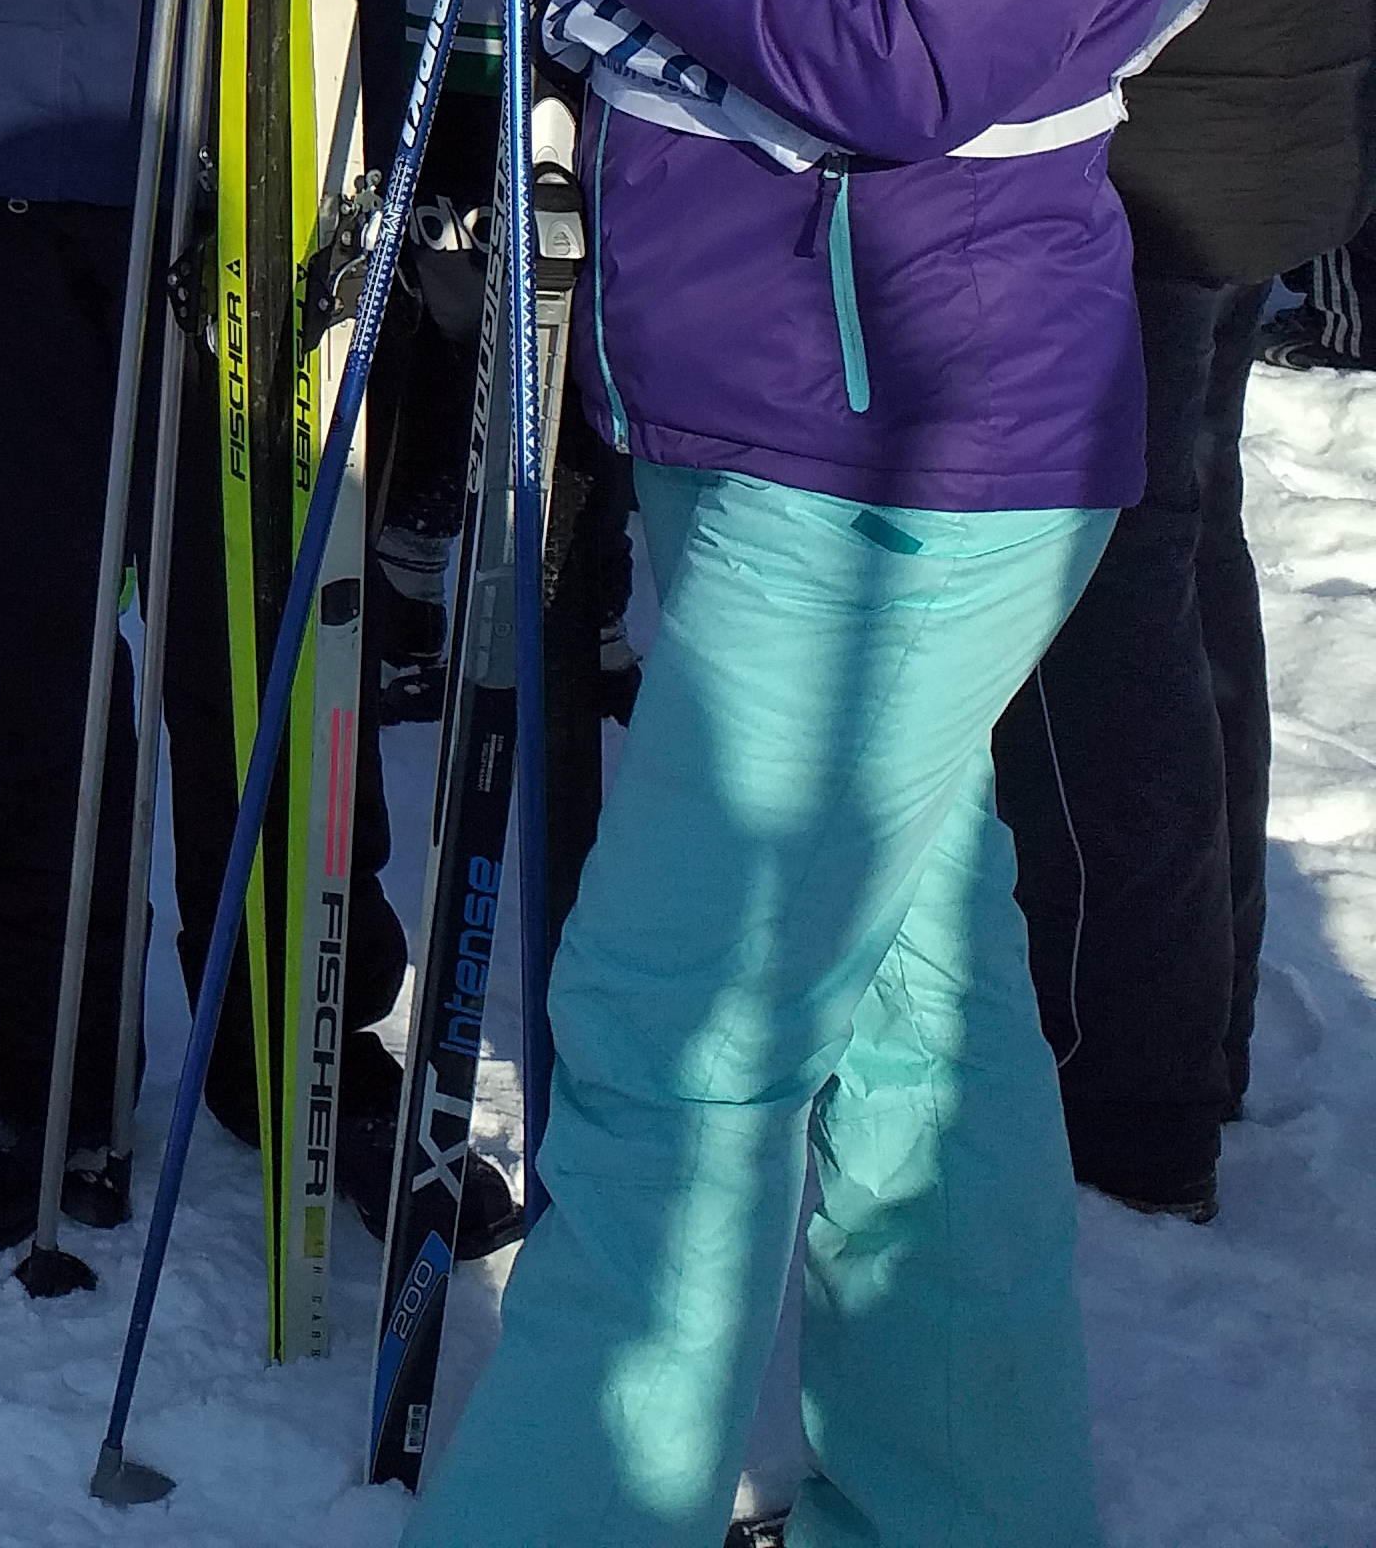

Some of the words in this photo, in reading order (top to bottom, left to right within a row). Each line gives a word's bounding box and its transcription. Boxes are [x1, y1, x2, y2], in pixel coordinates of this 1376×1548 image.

[226, 291, 247, 482] FISCHER
[304, 890, 352, 1199] FISCHER
[438, 854, 502, 1056] Intense
[391, 1257, 435, 1342] 200
